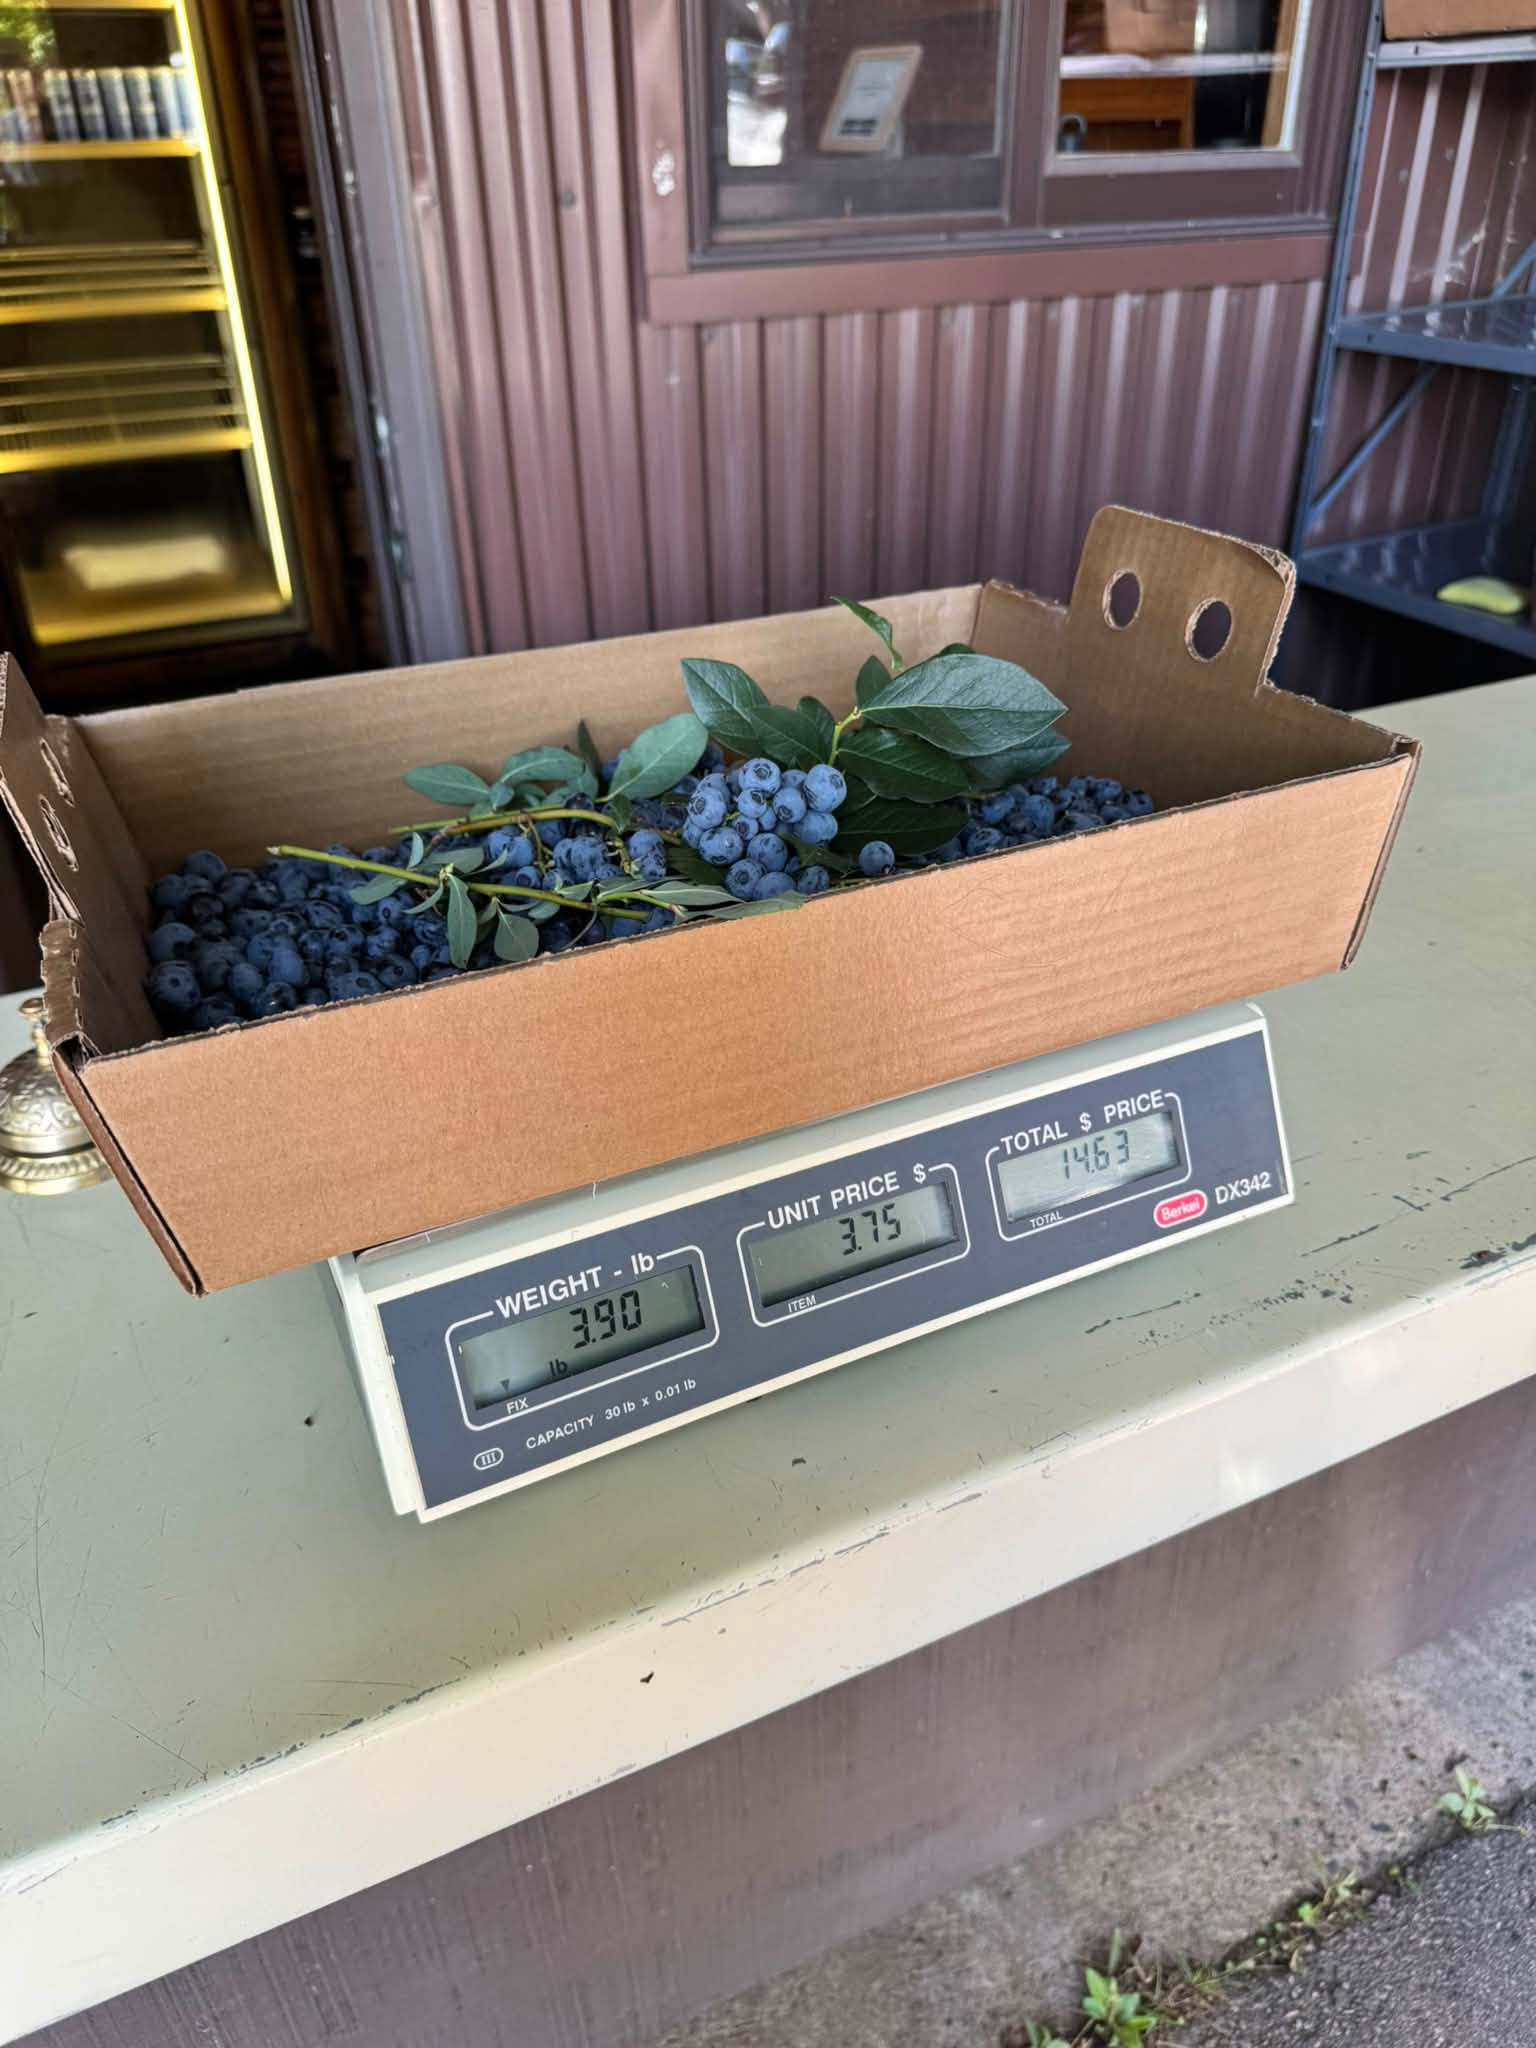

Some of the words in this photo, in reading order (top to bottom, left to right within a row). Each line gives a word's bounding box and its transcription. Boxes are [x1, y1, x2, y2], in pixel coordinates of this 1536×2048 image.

[1001, 1120, 1068, 1155] TOTAL
[1079, 1112, 1092, 1132] $
[1103, 1089, 1164, 1124] PRICE
[1061, 1129, 1131, 1179] 14.63
[767, 1195, 821, 1229] UNIT
[830, 1171, 900, 1210] PRICE
[913, 1163, 926, 1184] $
[1160, 1198, 1201, 1221] Berkel
[1214, 1171, 1272, 1205] DX342
[838, 1203, 901, 1255] 3.75
[1029, 1211, 1063, 1230] TOTAL
[496, 1266, 602, 1320] WEIGHT
[631, 1252, 655, 1275] lb
[788, 1295, 816, 1313] ITEM
[569, 1289, 642, 1349] 3.90
[549, 1359, 568, 1378] lb
[506, 1397, 529, 1415] FIX
[525, 1414, 595, 1450] CAPACITY
[605, 1404, 621, 1420] 30
[622, 1401, 635, 1415] lb
[642, 1397, 649, 1407] x
[655, 1384, 682, 1401] 0.01
[684, 1377, 696, 1391] lb
